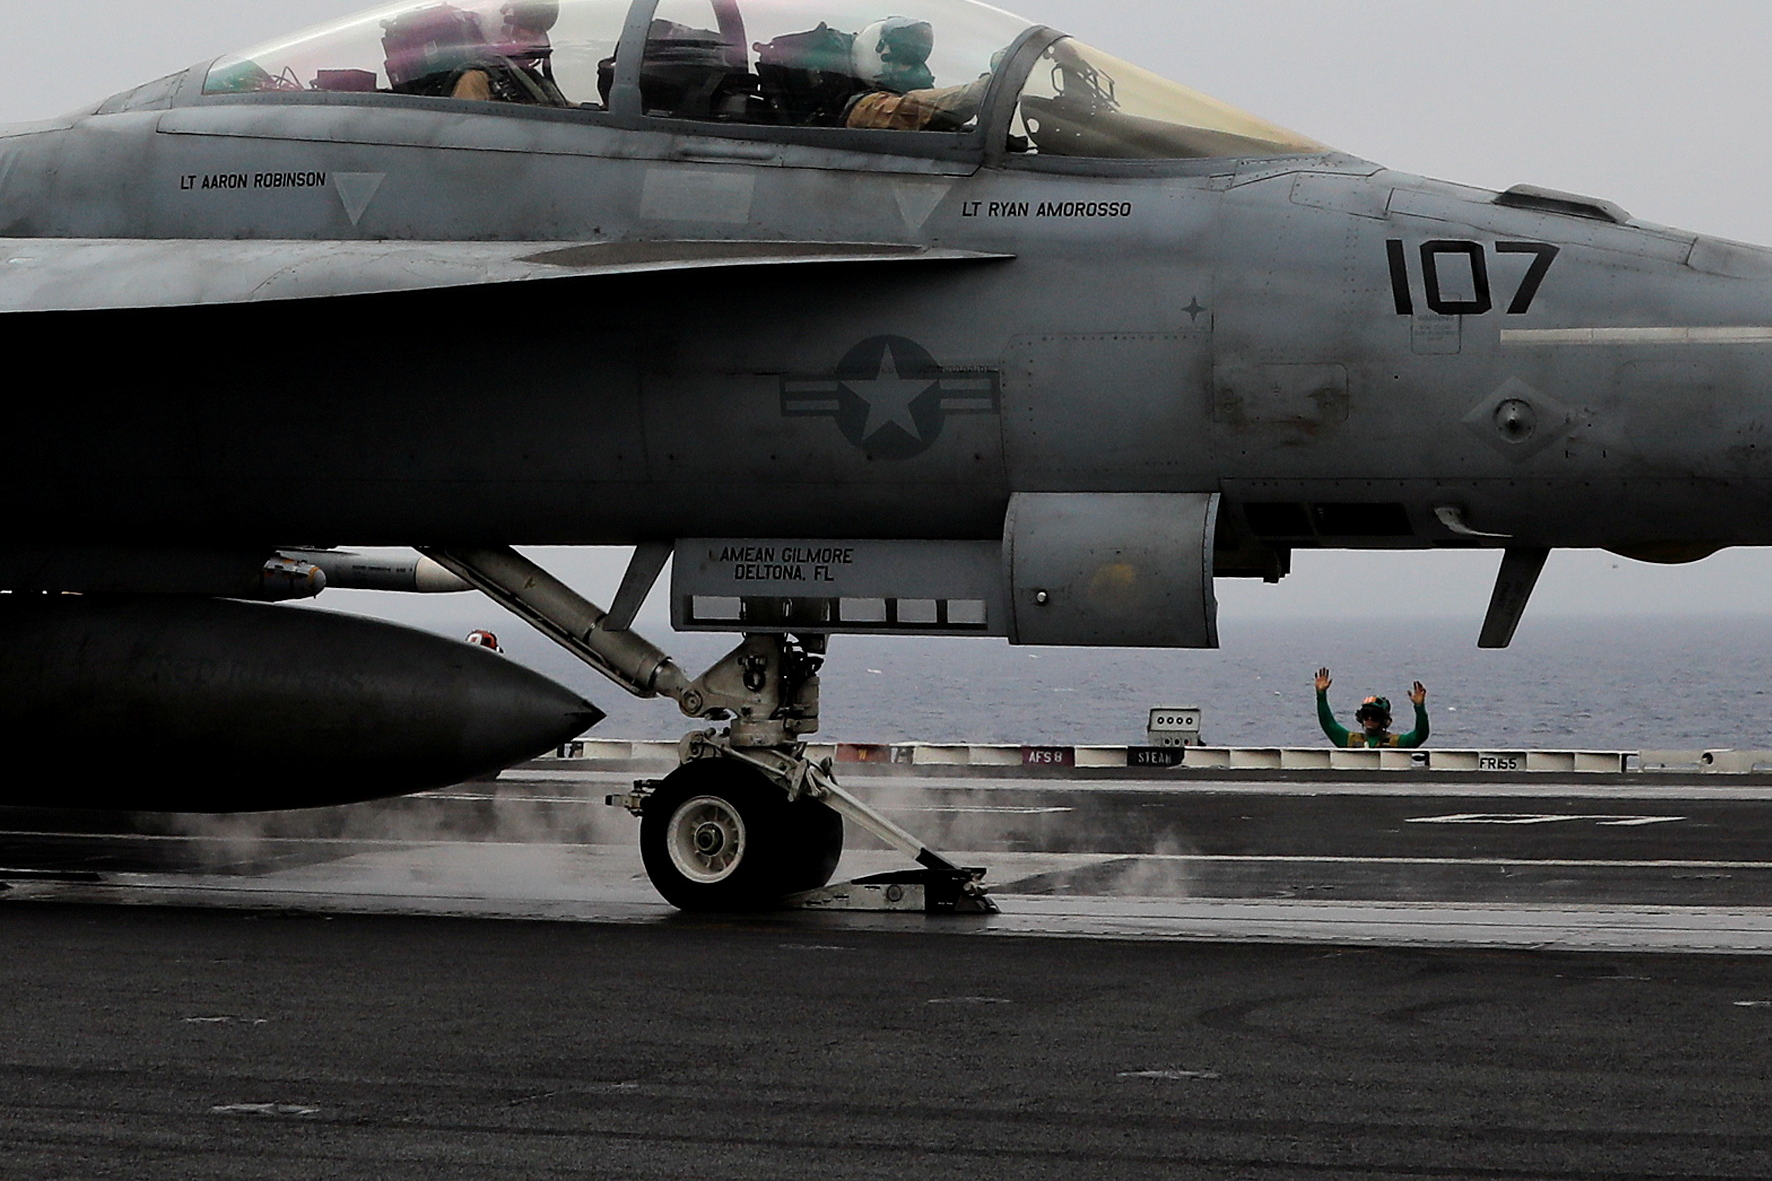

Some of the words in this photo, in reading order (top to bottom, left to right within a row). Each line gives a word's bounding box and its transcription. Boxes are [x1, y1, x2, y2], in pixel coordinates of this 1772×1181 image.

[181, 175, 196, 189] LT
[201, 174, 247, 188] AARON
[254, 172, 326, 187] ROBINSON
[962, 202, 981, 216] LT
[988, 202, 1029, 216] RYAN
[1036, 202, 1132, 216] AMOROSSO
[1386, 239, 1560, 314] 107
[781, 548, 854, 563] GILMORE
[814, 566, 834, 581] FL
[1029, 751, 1051, 762] AFS
